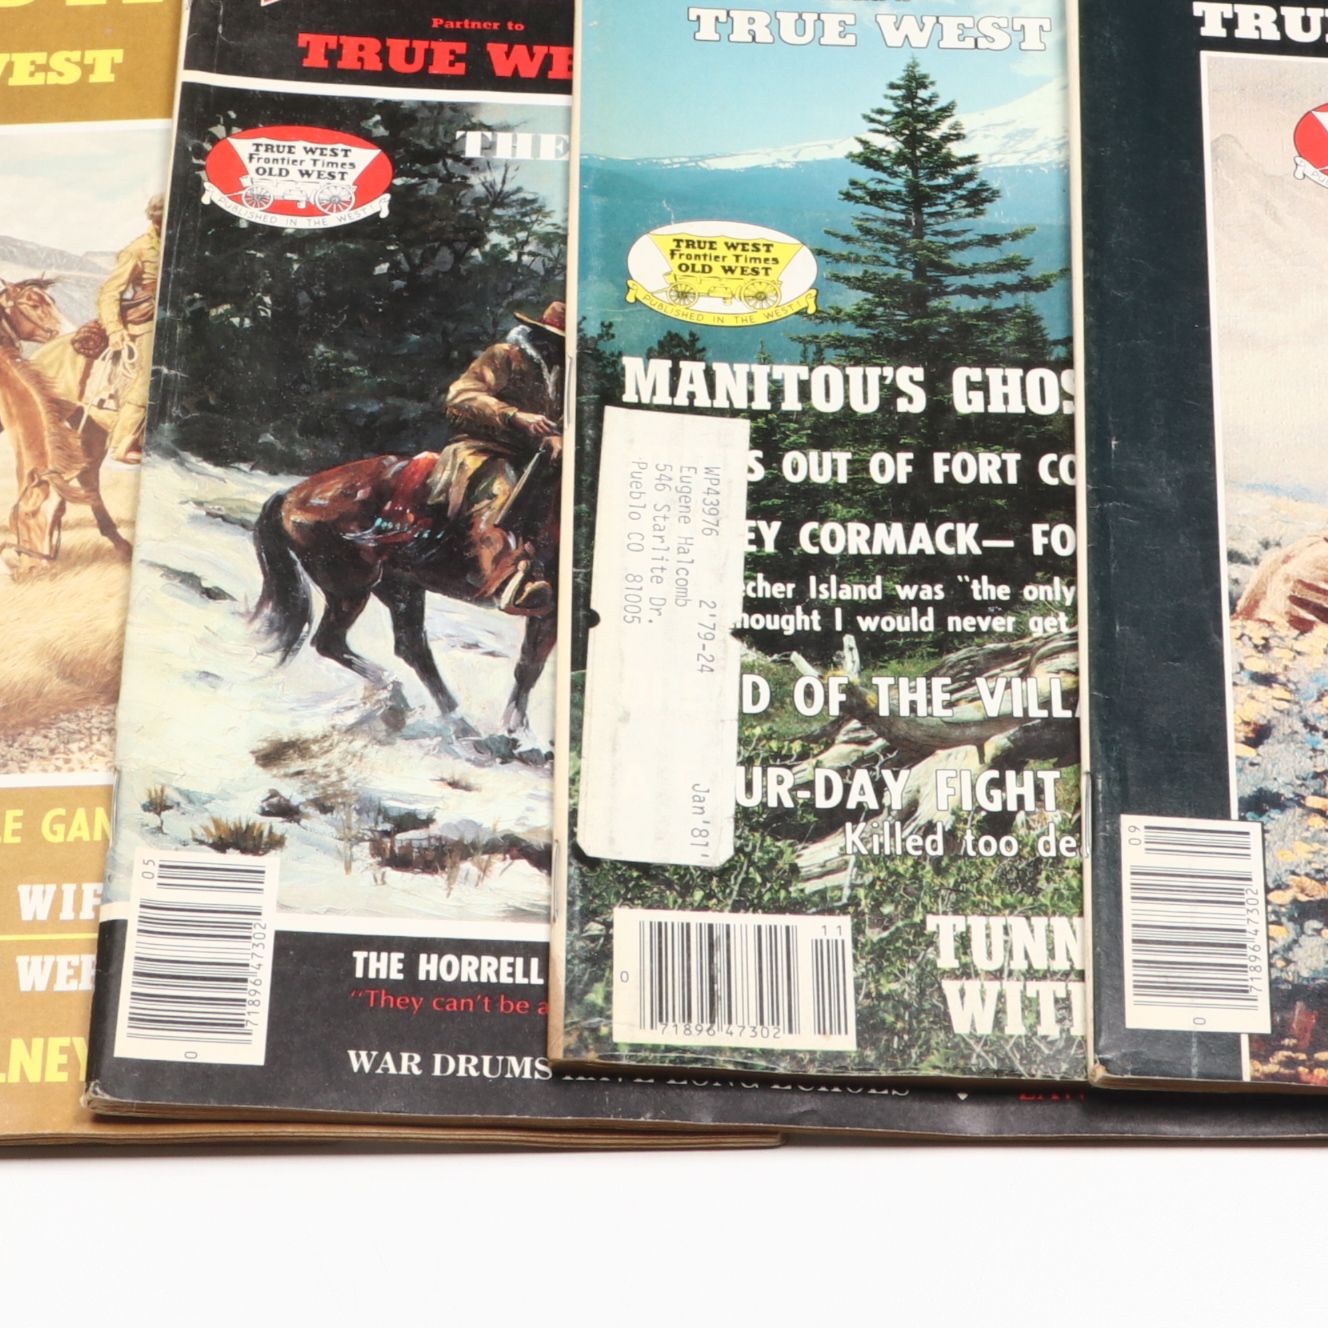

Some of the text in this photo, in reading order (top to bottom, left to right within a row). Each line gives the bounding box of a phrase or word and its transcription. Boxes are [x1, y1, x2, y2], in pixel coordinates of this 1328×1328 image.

[622, 356, 926, 414] MANITOU'S
[782, 452, 1021, 485] OUT OF FORT
[702, 466, 719, 538] WP43976
[623, 459, 648, 624] Pueblo CO 81005
[646, 463, 672, 624] 546 Starlite Dr.
[674, 466, 697, 608] Eugene Halcomb
[352, 950, 543, 984] THE HORRELL
[348, 1050, 553, 1080] WAR DRUMS
